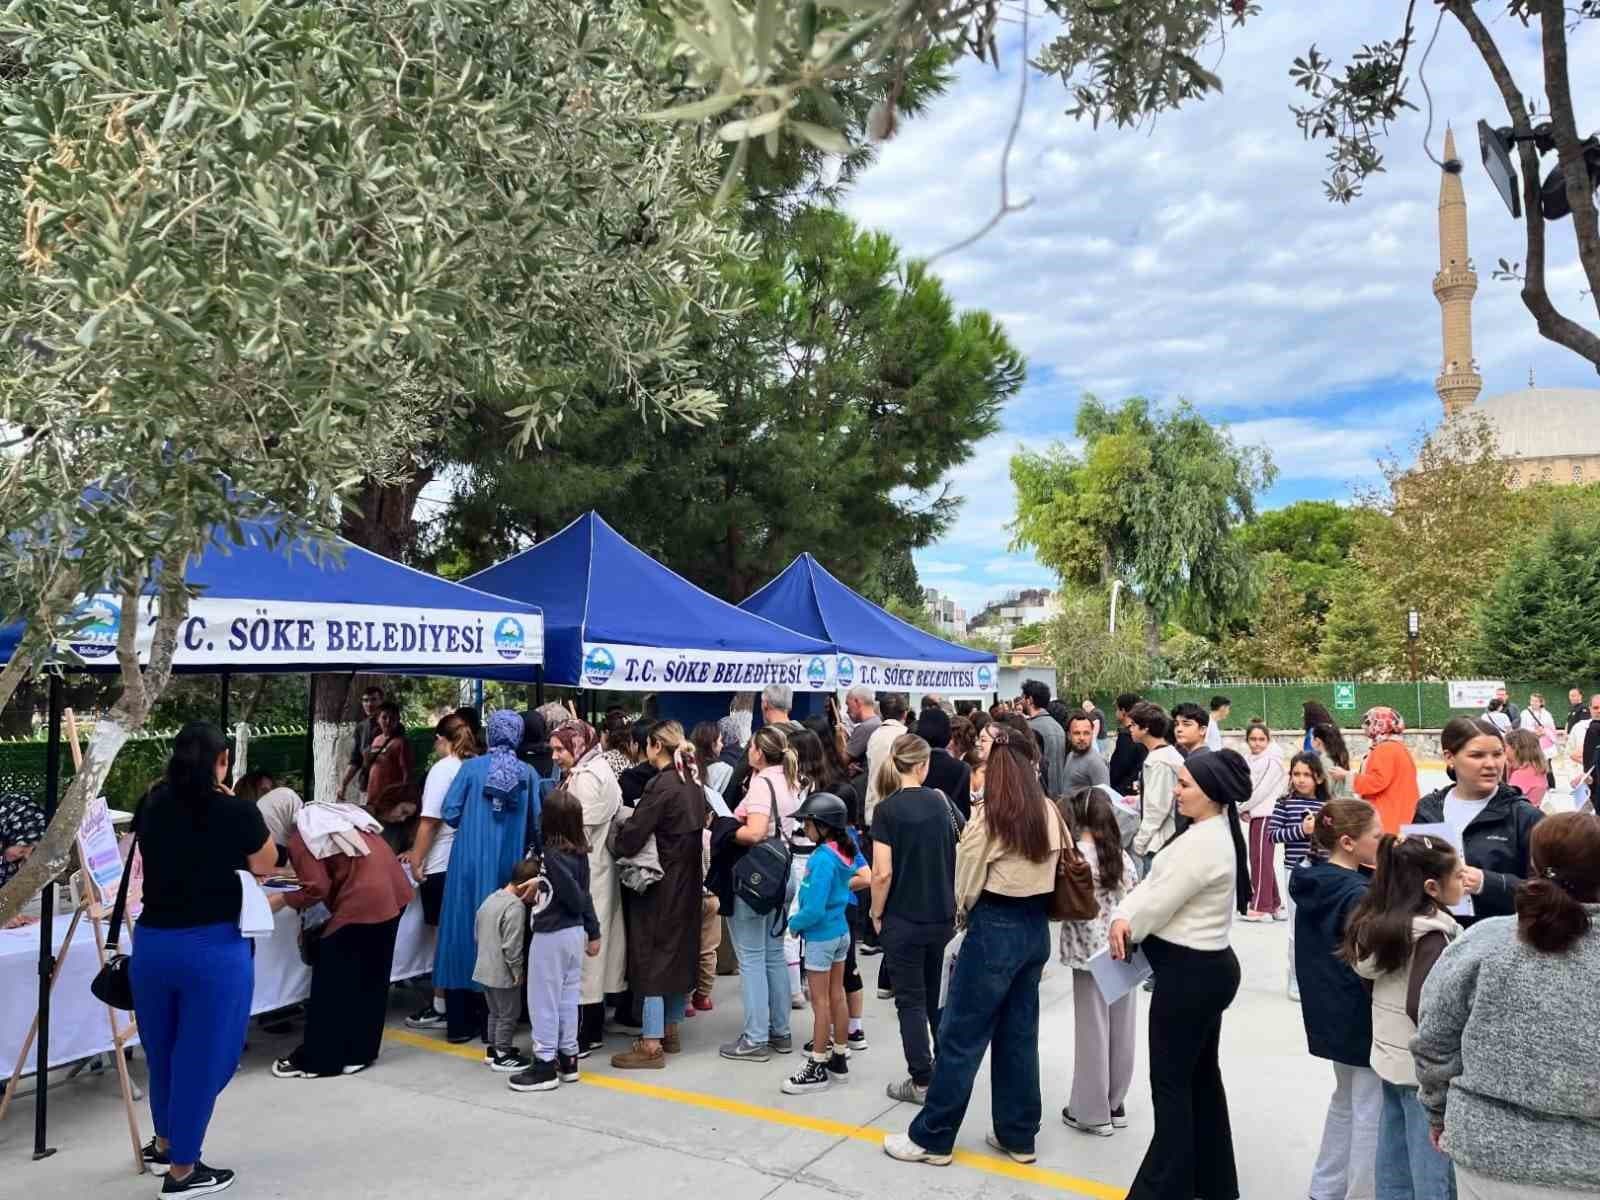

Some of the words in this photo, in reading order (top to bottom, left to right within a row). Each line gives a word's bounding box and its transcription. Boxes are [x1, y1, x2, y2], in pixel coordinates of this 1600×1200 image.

[229, 608, 315, 652] SÖKE
[326, 615, 484, 653] BELEDİYESİ
[625, 658, 657, 682] T.C.
[663, 654, 711, 683] SÖKE
[712, 657, 803, 684] BELEDİYESİ
[860, 665, 880, 685] T.C.
[884, 663, 914, 686] SÖKE
[916, 666, 975, 688] BELEDİYESİ
